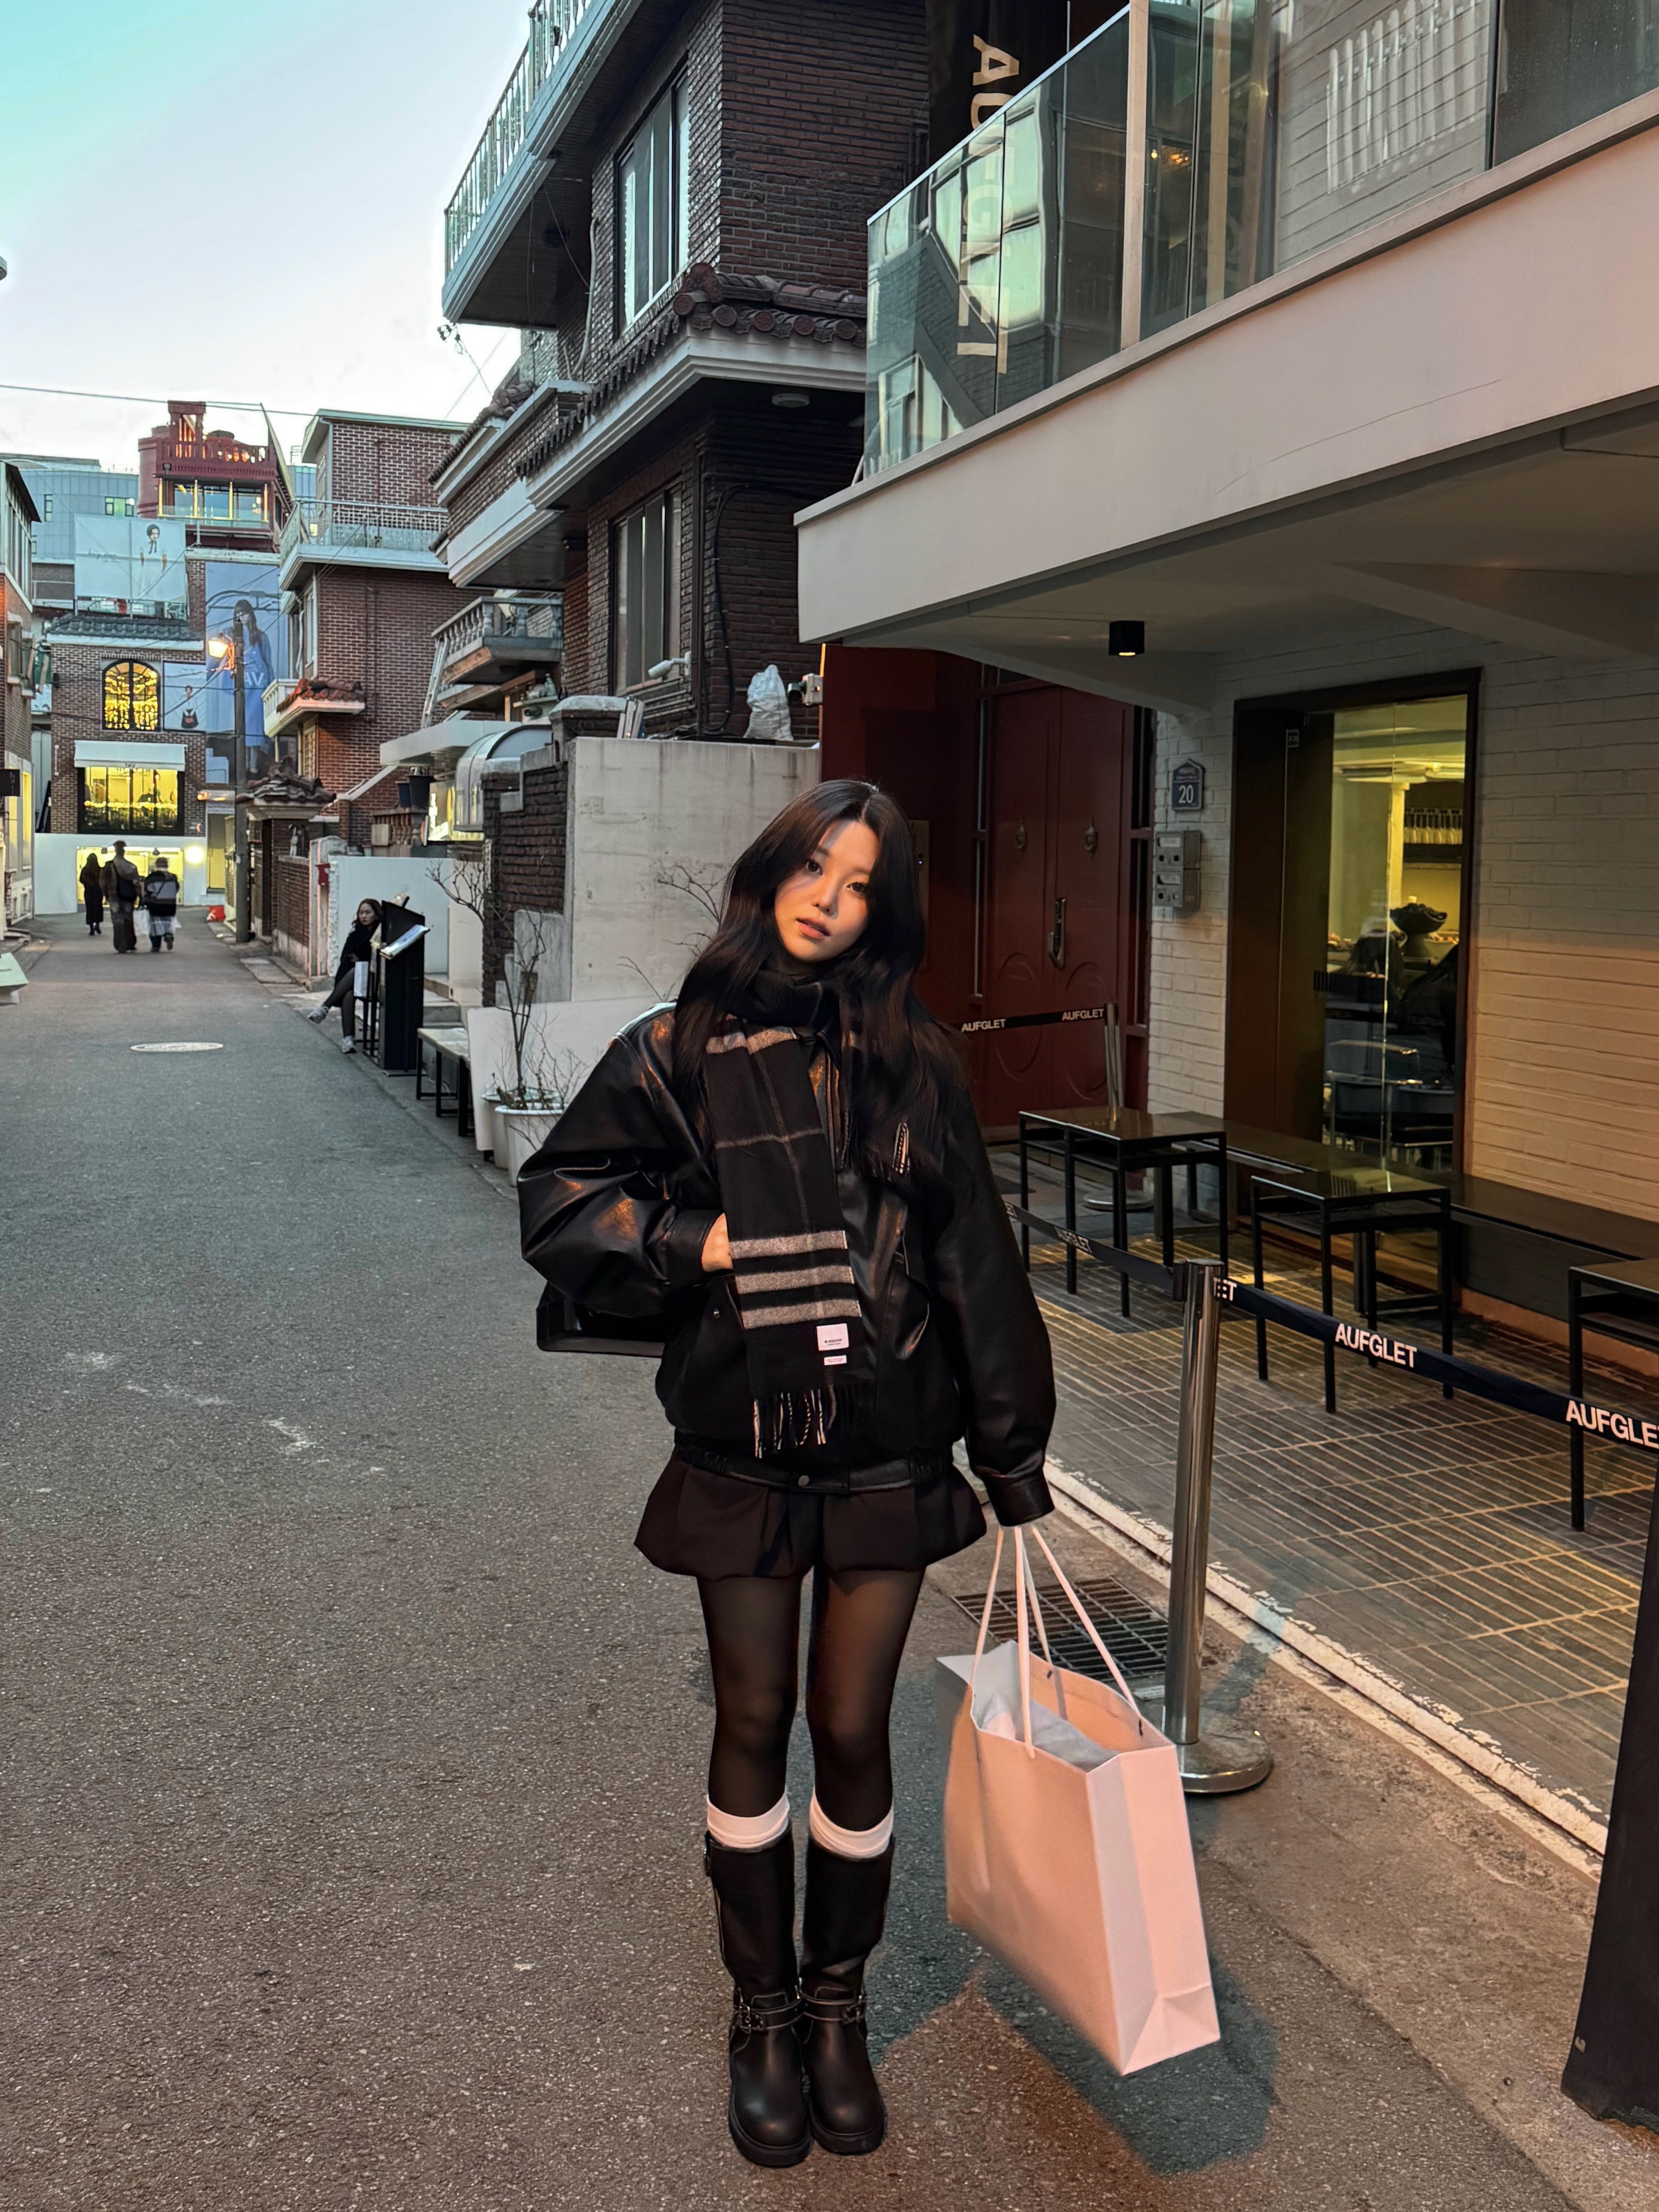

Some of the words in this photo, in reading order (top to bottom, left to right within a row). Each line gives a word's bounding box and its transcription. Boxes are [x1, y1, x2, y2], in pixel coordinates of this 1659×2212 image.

[1178, 785, 1194, 804] 20
[1062, 1009, 1104, 1020] AUFGLET
[961, 1019, 1006, 1032] AUFGLET
[1335, 1323, 1417, 1367] AUFGLET
[1566, 1400, 1659, 1449] AUFGLE
